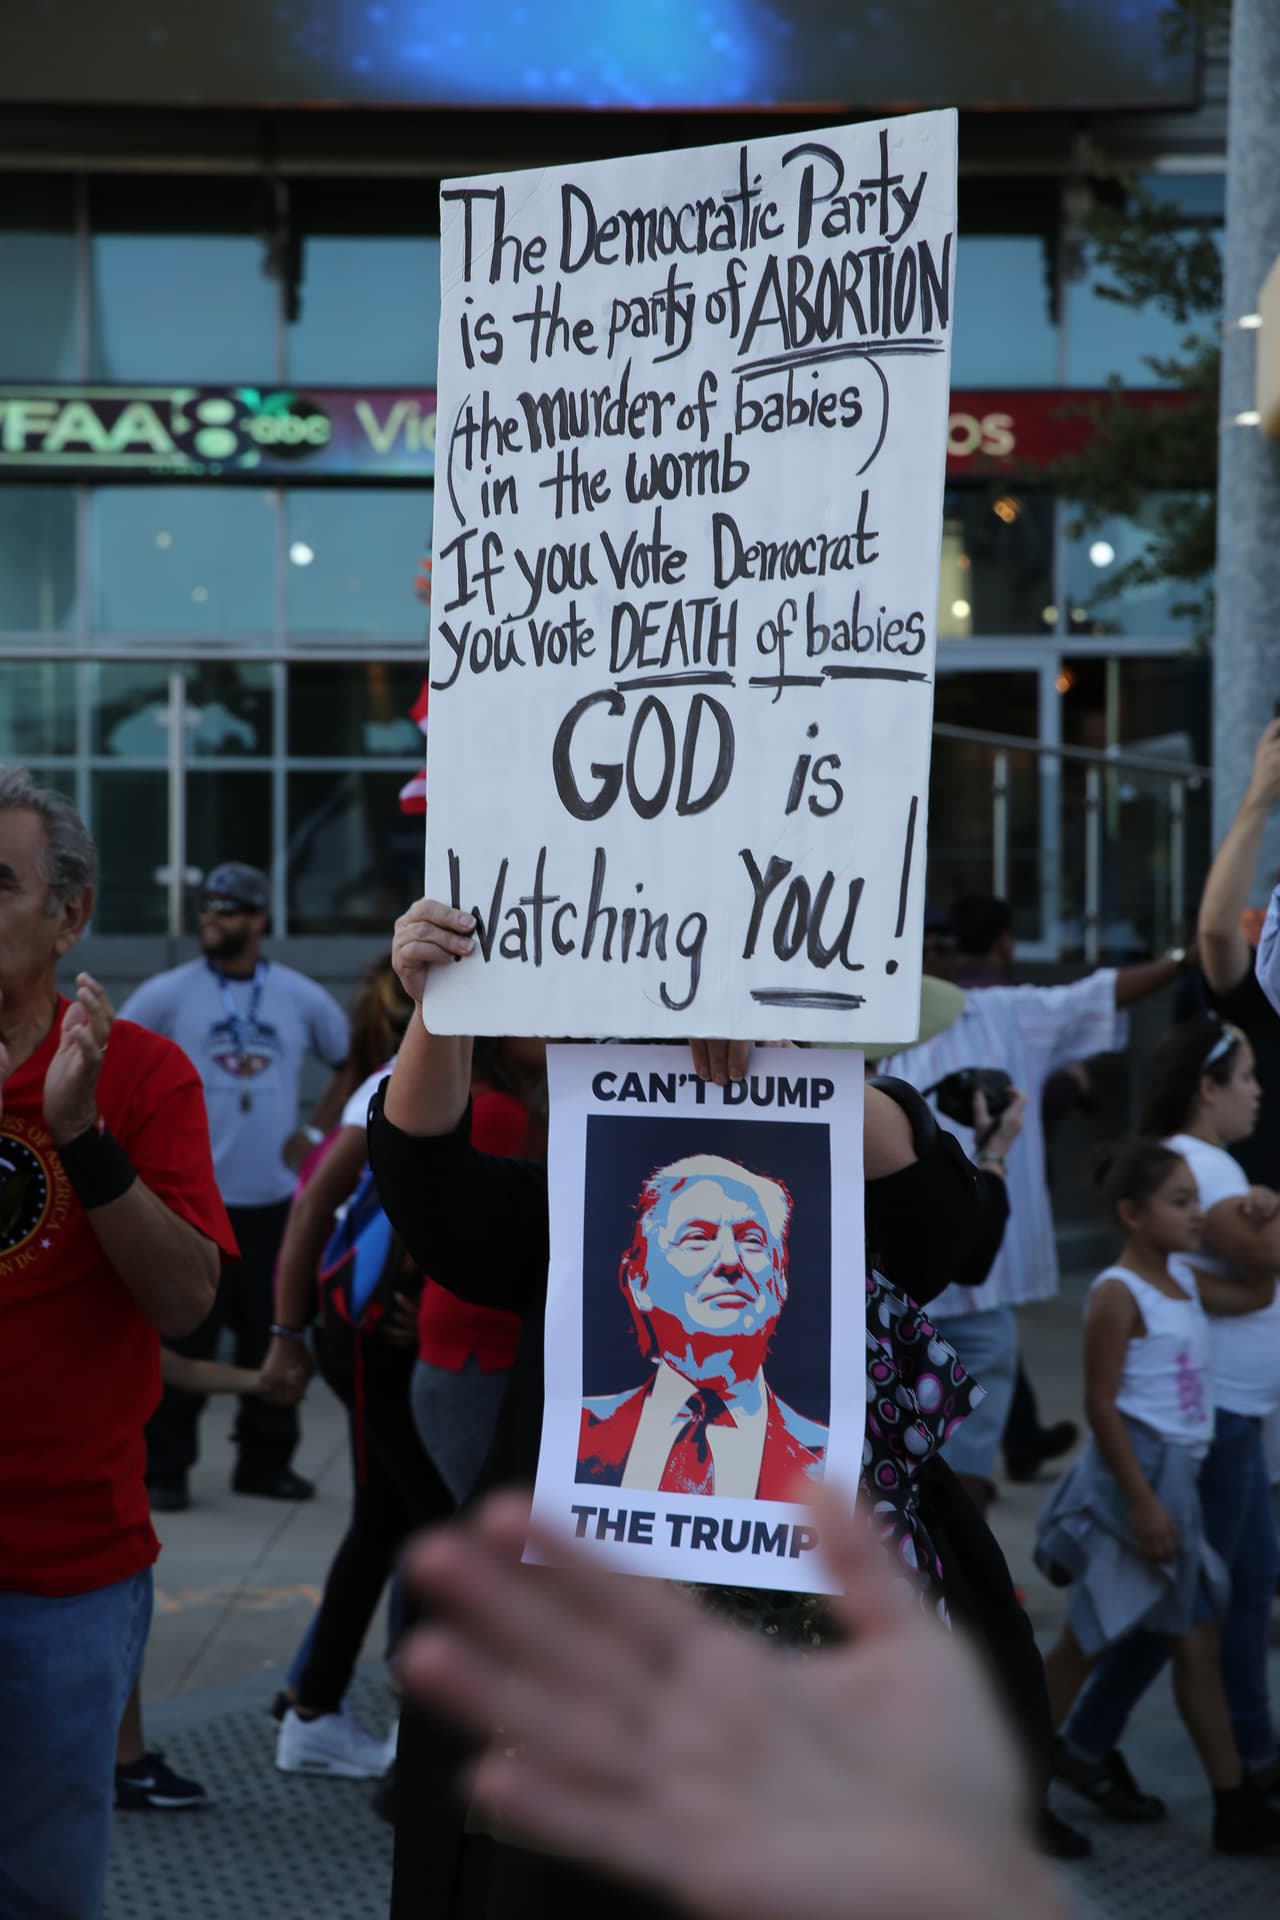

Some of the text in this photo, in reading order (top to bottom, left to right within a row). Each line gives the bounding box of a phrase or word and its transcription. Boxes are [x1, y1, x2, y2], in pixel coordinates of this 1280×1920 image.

[441, 129, 928, 284] The Democratic Party
[461, 232, 952, 369] is the party of ABORTION
[516, 357, 676, 454] murder
[676, 370, 718, 441] of
[480, 433, 750, 520] in the womb
[440, 528, 504, 615] If
[504, 542, 598, 621] you
[712, 489, 879, 589] Democrat
[431, 613, 525, 690] you
[609, 597, 737, 674] DEATH
[757, 598, 798, 703] of
[806, 590, 926, 656] babies
[552, 689, 844, 821] GOD is
[447, 846, 708, 1011] Watching
[723, 1075, 835, 1108] DUMP
[570, 1504, 819, 1560] THE TRUMP
